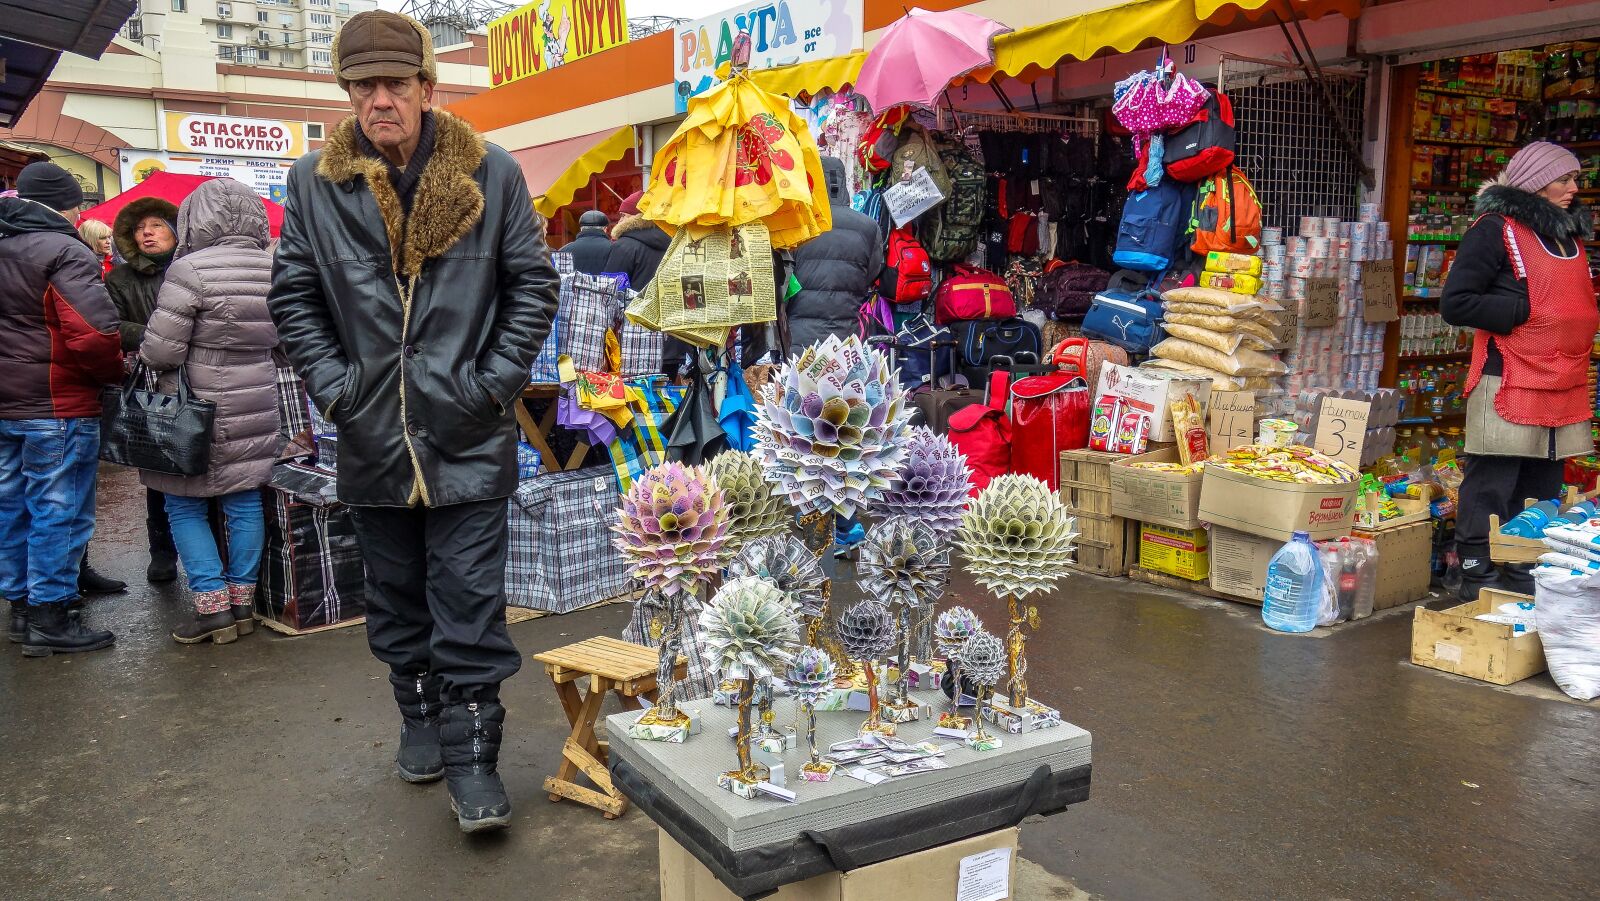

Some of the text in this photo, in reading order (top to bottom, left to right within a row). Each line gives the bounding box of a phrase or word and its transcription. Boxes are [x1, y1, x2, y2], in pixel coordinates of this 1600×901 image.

[490, 0, 623, 86] ШОТИС ПУРИ
[679, 0, 798, 72] РАДУГА
[1184, 43, 1196, 64] 10
[962, 85, 968, 101] 9
[189, 120, 283, 139] СПАСИБО
[190, 135, 289, 152] ЗА ПОКУПКУ!
[1217, 412, 1235, 449] 4
[1322, 418, 1347, 457] 3
[1464, 558, 1478, 566] NIKE
